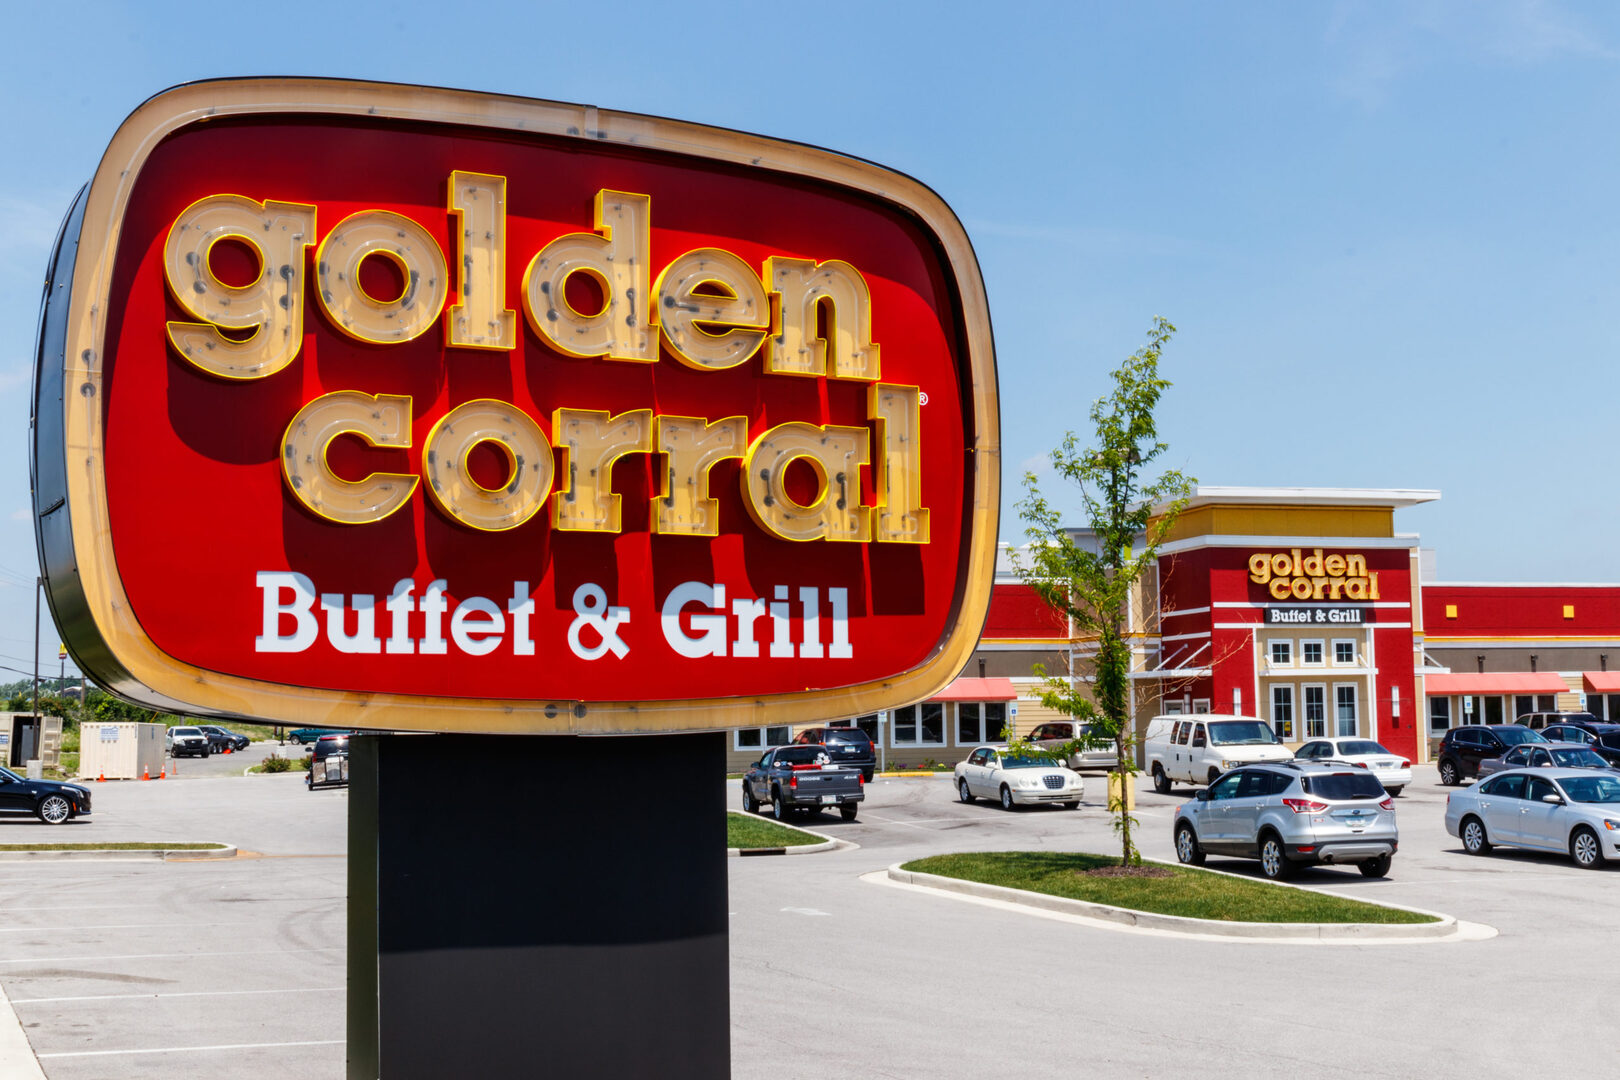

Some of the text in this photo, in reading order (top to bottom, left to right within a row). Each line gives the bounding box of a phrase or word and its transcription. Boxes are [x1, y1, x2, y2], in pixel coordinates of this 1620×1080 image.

[163, 170, 881, 381] golden
[280, 382, 931, 544] corral
[1248, 548, 1368, 584] golden
[1269, 572, 1380, 600] corral
[255, 571, 854, 660] Buffet & Grill
[1271, 609, 1361, 623] Buffet & Grill
